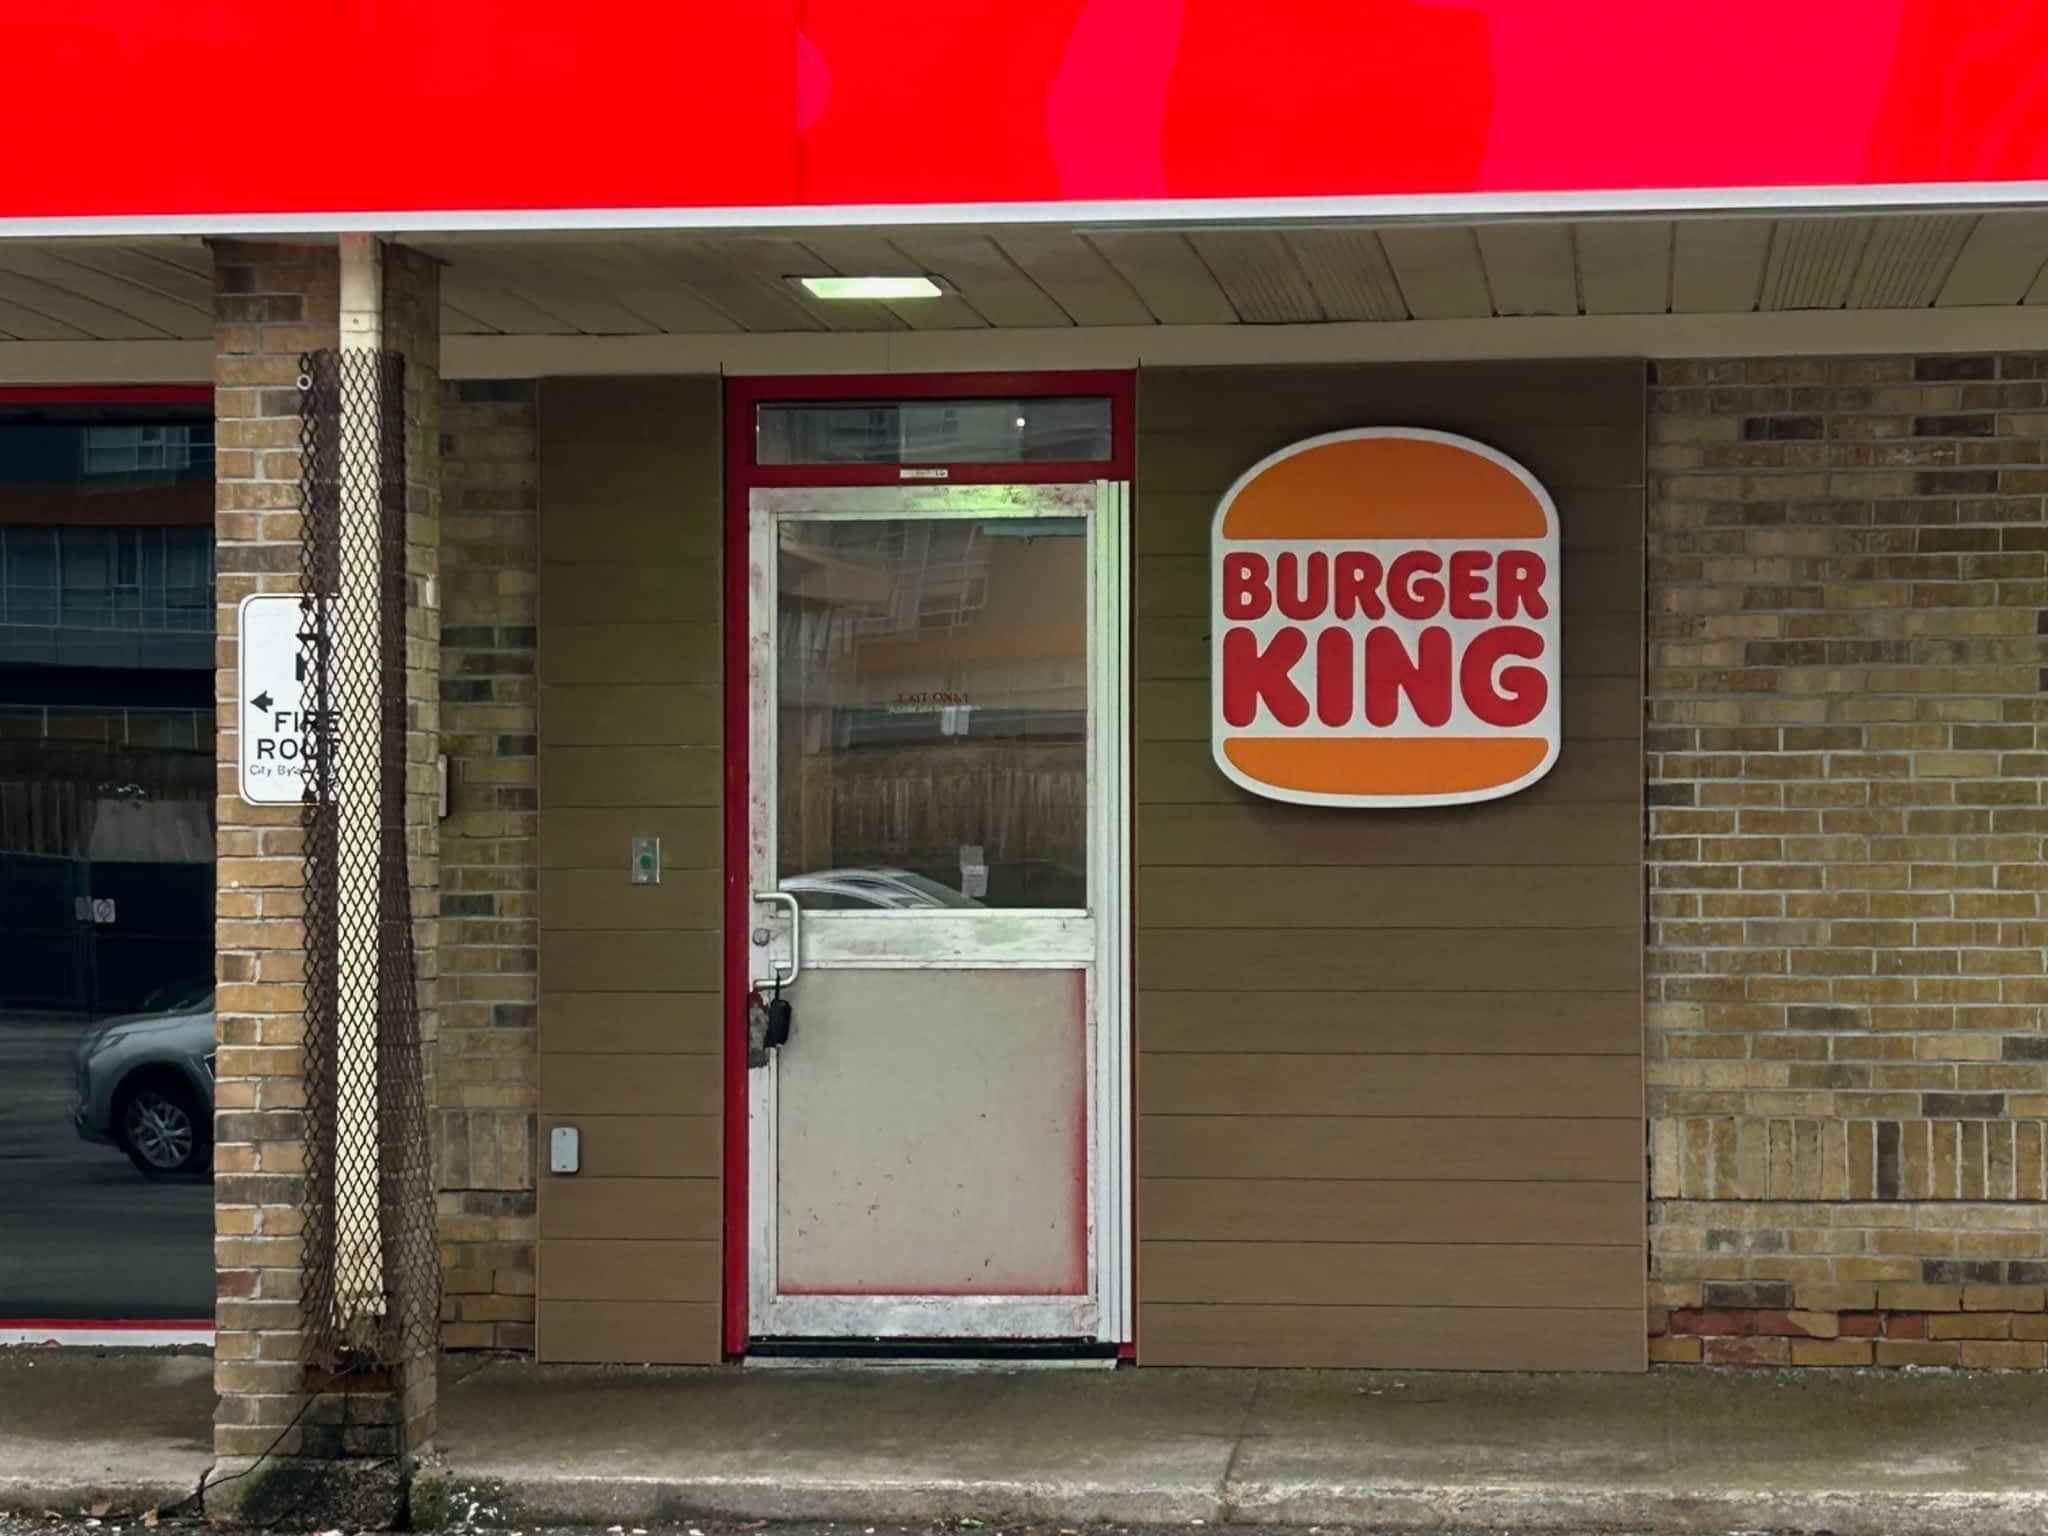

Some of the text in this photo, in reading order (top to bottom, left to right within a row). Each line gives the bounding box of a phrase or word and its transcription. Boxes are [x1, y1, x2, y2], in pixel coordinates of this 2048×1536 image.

[1222, 550, 1549, 621] BURGER
[1222, 625, 1548, 728] KING
[274, 711, 342, 733] FIRE
